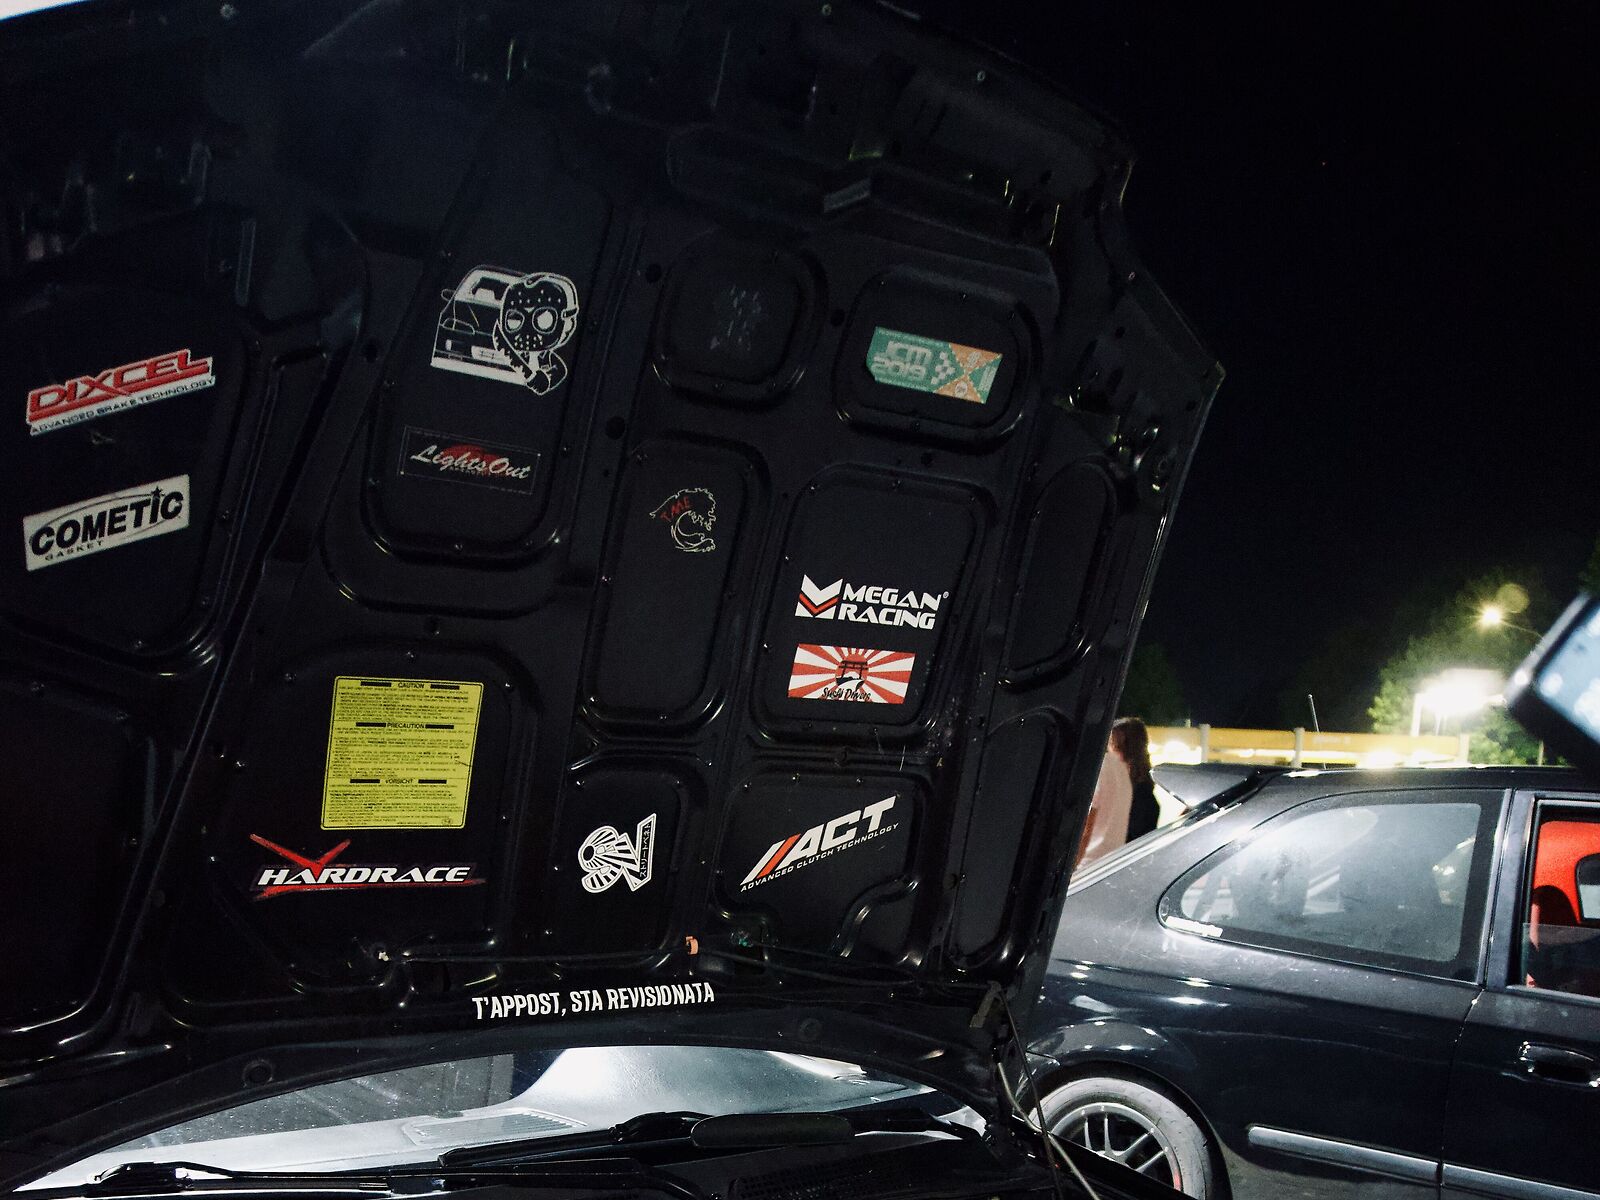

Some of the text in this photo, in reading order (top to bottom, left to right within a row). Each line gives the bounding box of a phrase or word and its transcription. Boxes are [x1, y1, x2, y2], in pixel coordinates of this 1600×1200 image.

[28, 350, 209, 416] DIXCEL
[31, 378, 214, 433] ADVANCED BRAKE TECHNOLOGY
[31, 488, 184, 556] COMETIC
[45, 540, 104, 561] GASKET
[838, 603, 936, 630] RACING
[842, 583, 942, 611] MEGAN
[775, 795, 896, 871] ACT
[257, 867, 471, 886] HARDRACE
[741, 822, 899, 892] ADVANCED CLUTCH TECHNOLOGY
[569, 989, 603, 1013] STA
[606, 982, 715, 1010] REVISIONATA
